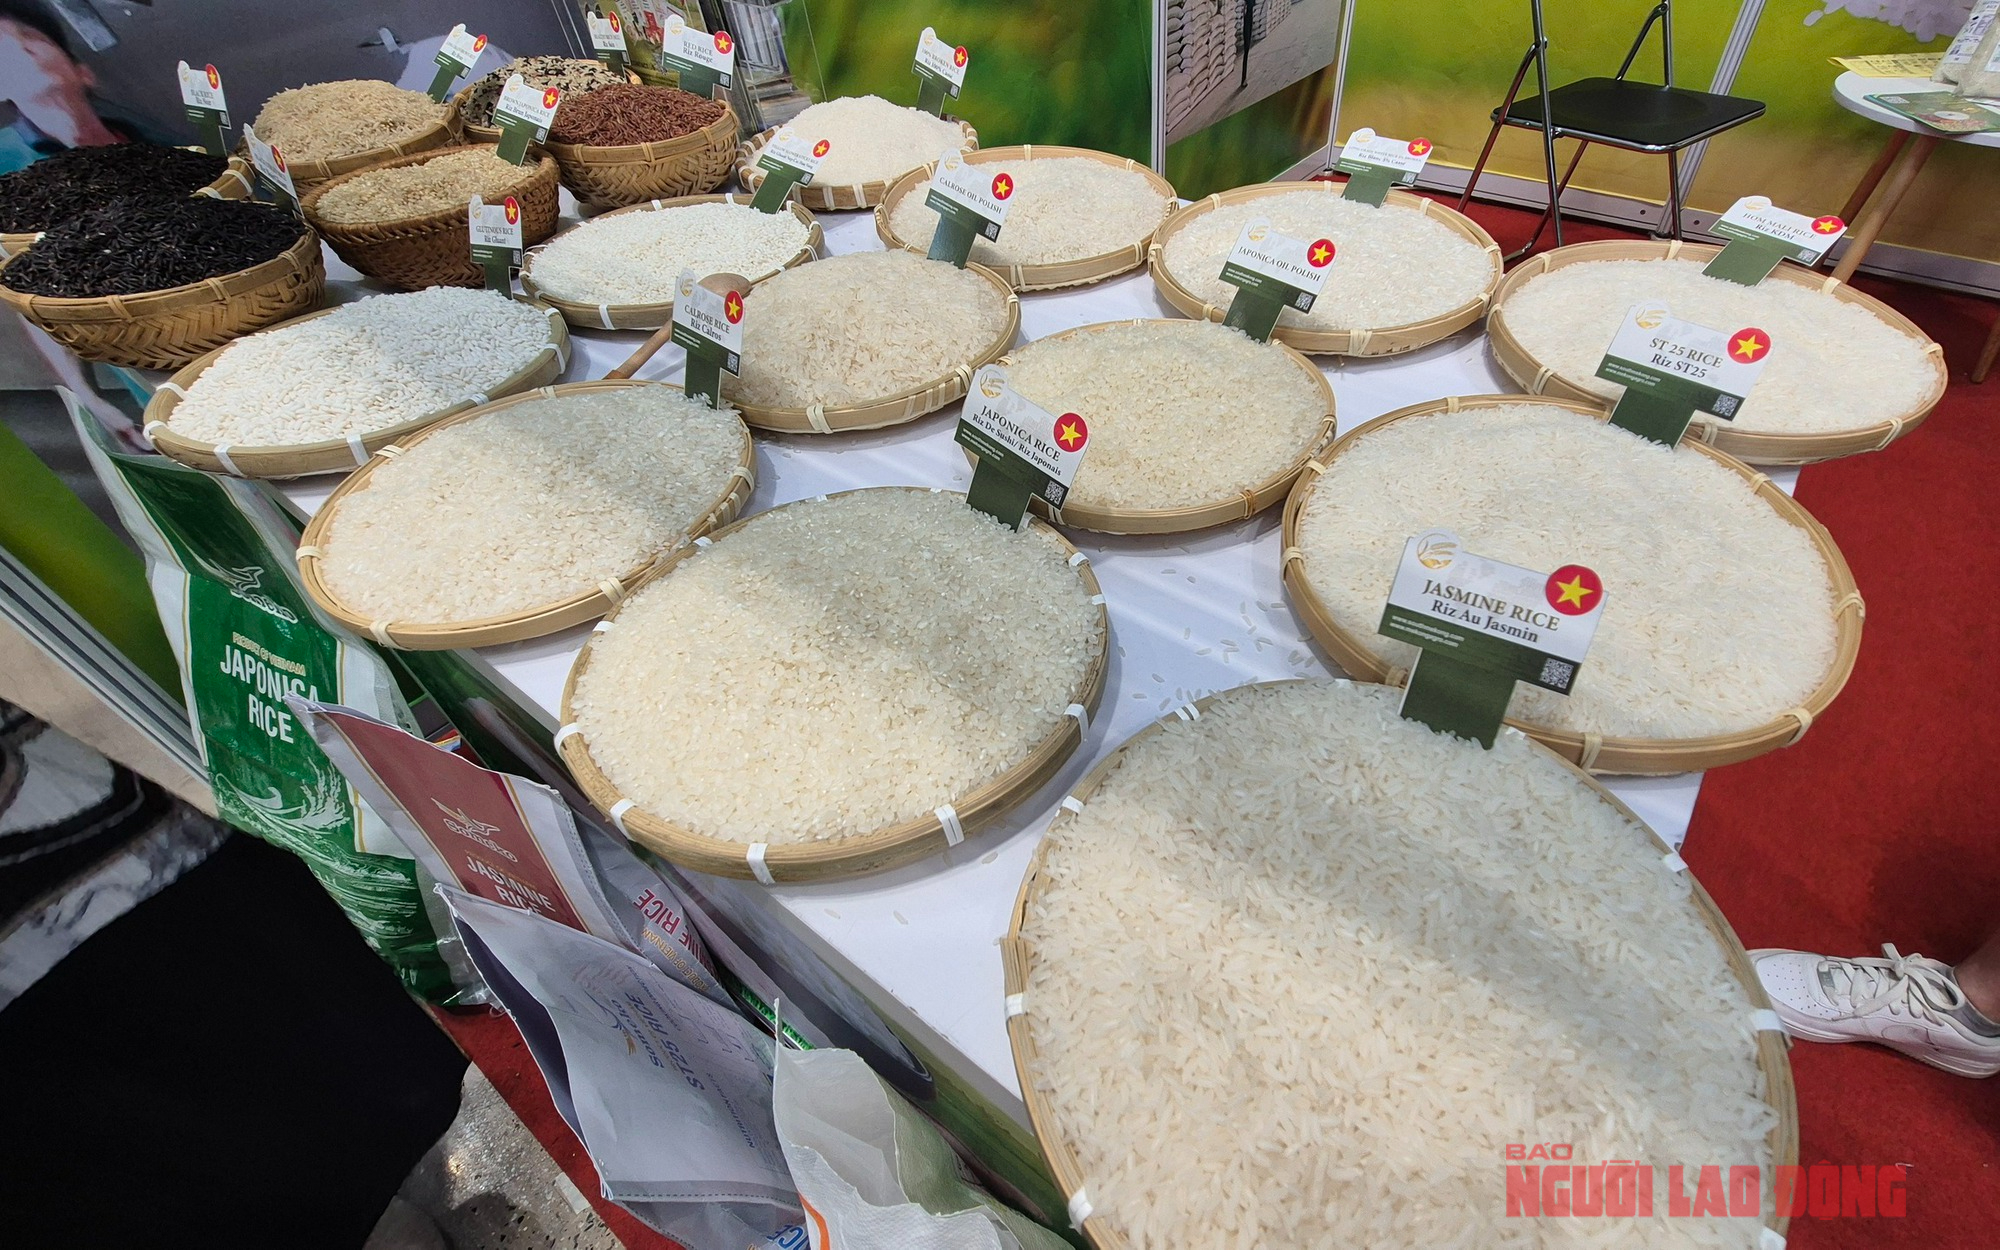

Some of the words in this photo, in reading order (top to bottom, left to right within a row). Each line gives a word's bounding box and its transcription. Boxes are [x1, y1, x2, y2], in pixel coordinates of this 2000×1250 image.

[683, 46, 693, 56] Riz
[694, 50, 714, 63] Rouge
[684, 40, 696, 50] RED
[698, 46, 713, 56] RICE
[940, 176, 966, 196] CALROSE
[967, 192, 978, 202] OIL
[978, 197, 1002, 214] POLISH
[476, 226, 502, 235] GLUTINOUS
[502, 228, 514, 236] RICE
[492, 236, 506, 244] Gluant
[1743, 212, 1766, 224] HOM
[1768, 220, 1792, 231] MALI
[1792, 226, 1816, 239] RICE
[1755, 224, 1770, 232] Riz
[1771, 229, 1795, 240] KDM
[1238, 246, 1276, 266] JAPONICA
[1276, 260, 1290, 271] OIL
[1291, 265, 1322, 282] POLISH
[684, 304, 713, 326] CALROSE
[714, 318, 730, 334] RICE
[690, 318, 701, 331] Riz
[702, 325, 722, 341] Calros
[1650, 337, 1670, 350] ST
[1671, 344, 1685, 356] 25
[1686, 348, 1723, 368] RICE
[1650, 353, 1671, 368] Riz
[1674, 361, 1708, 378] ST25
[972, 414, 984, 426] Riz
[985, 422, 995, 433] De
[995, 428, 1019, 447] Sushi/
[1019, 444, 1030, 456] Riz
[1031, 450, 1061, 476] Japonais
[981, 405, 1032, 444] JAPONICA
[1034, 436, 1060, 462] RICE
[1422, 579, 1506, 616] JASMINE
[1510, 606, 1560, 632] RICE
[1431, 599, 1457, 618] Riz
[1460, 609, 1480, 625] Au
[1483, 616, 1538, 643] Jasmin
[220, 644, 320, 703] JAPONICA
[232, 631, 260, 656] PRODUCT
[260, 646, 270, 661] OF
[269, 652, 306, 676] VIETNAM
[249, 694, 294, 744] RICE
[468, 856, 556, 912] JASMINE
[633, 888, 680, 935] RICE
[674, 958, 686, 968] OF
[611, 999, 665, 1069] Someko
[625, 992, 668, 1036] RICE
[662, 1038, 705, 1091] ST25
[723, 1097, 755, 1149] NUTRITION
